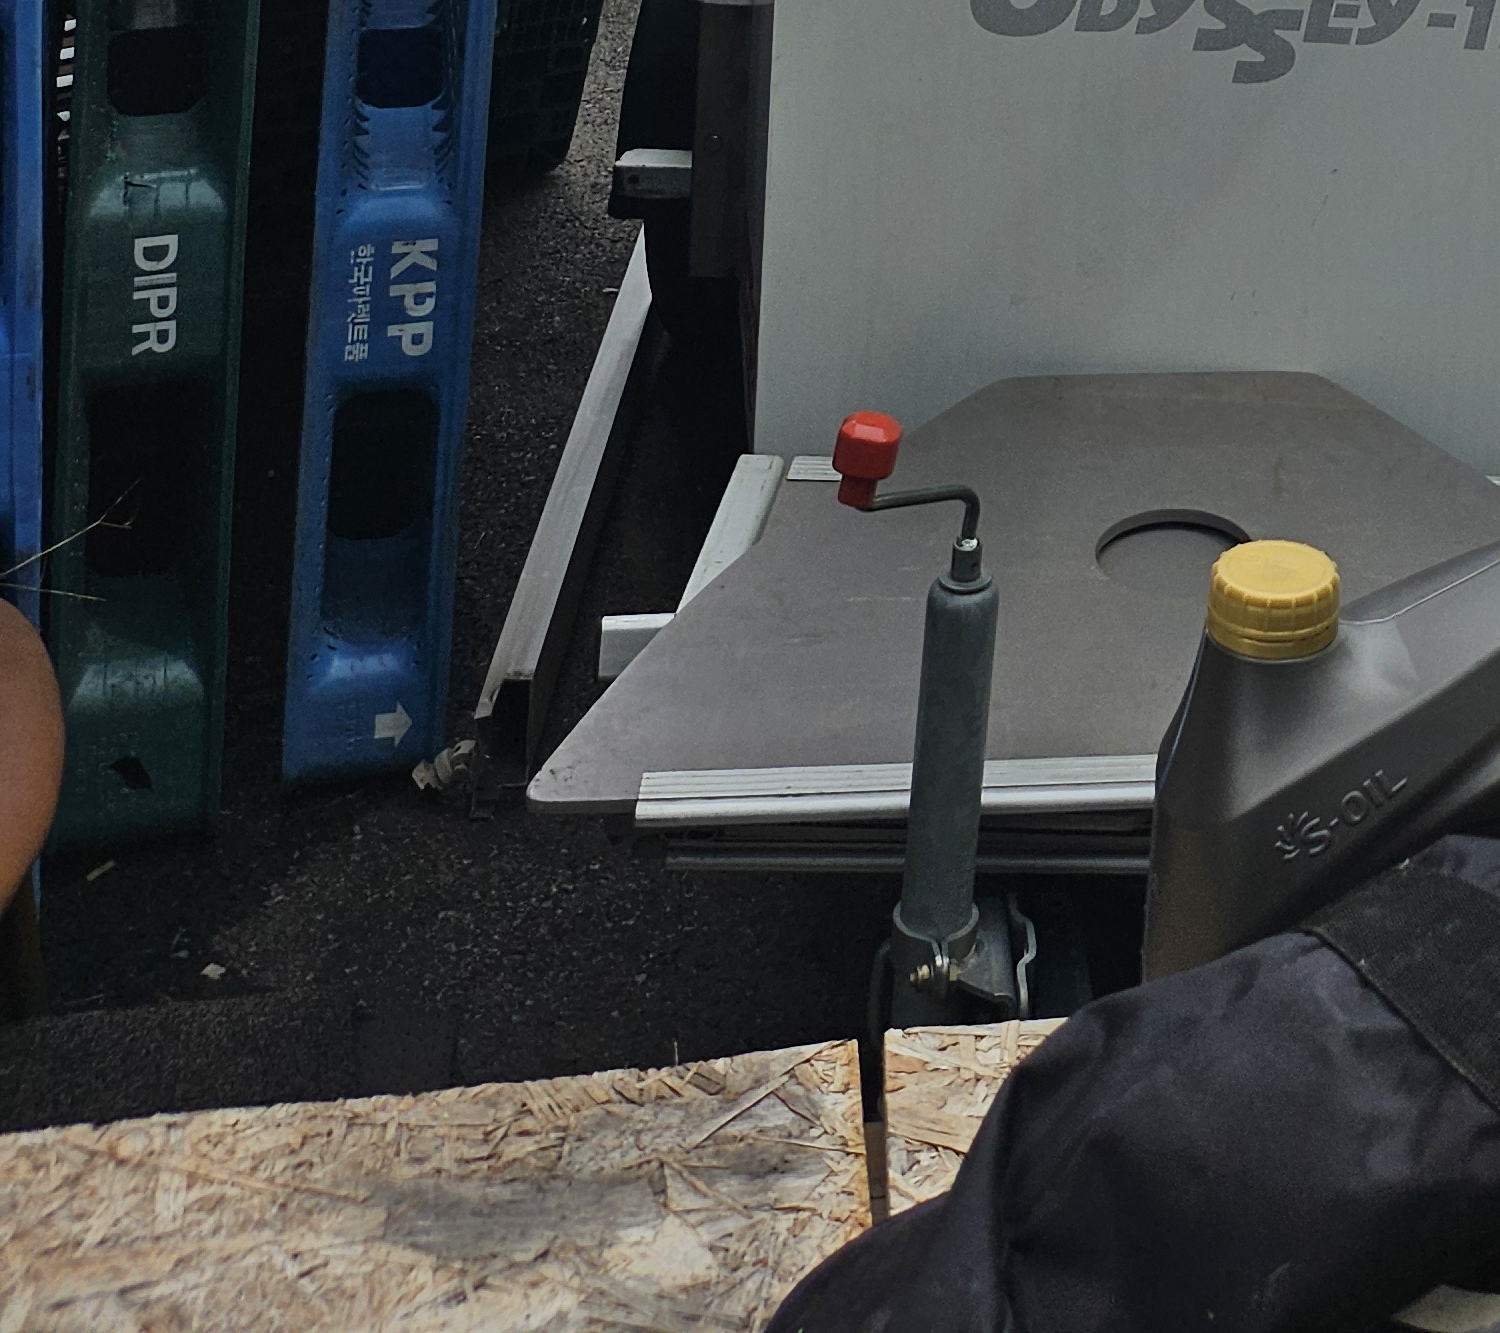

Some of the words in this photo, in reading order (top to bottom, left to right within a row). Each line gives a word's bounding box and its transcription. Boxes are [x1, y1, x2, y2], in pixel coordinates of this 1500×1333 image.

[131, 233, 178, 356] DIPR
[343, 243, 374, 361] 한국파렛트풀
[387, 238, 438, 357] KPP
